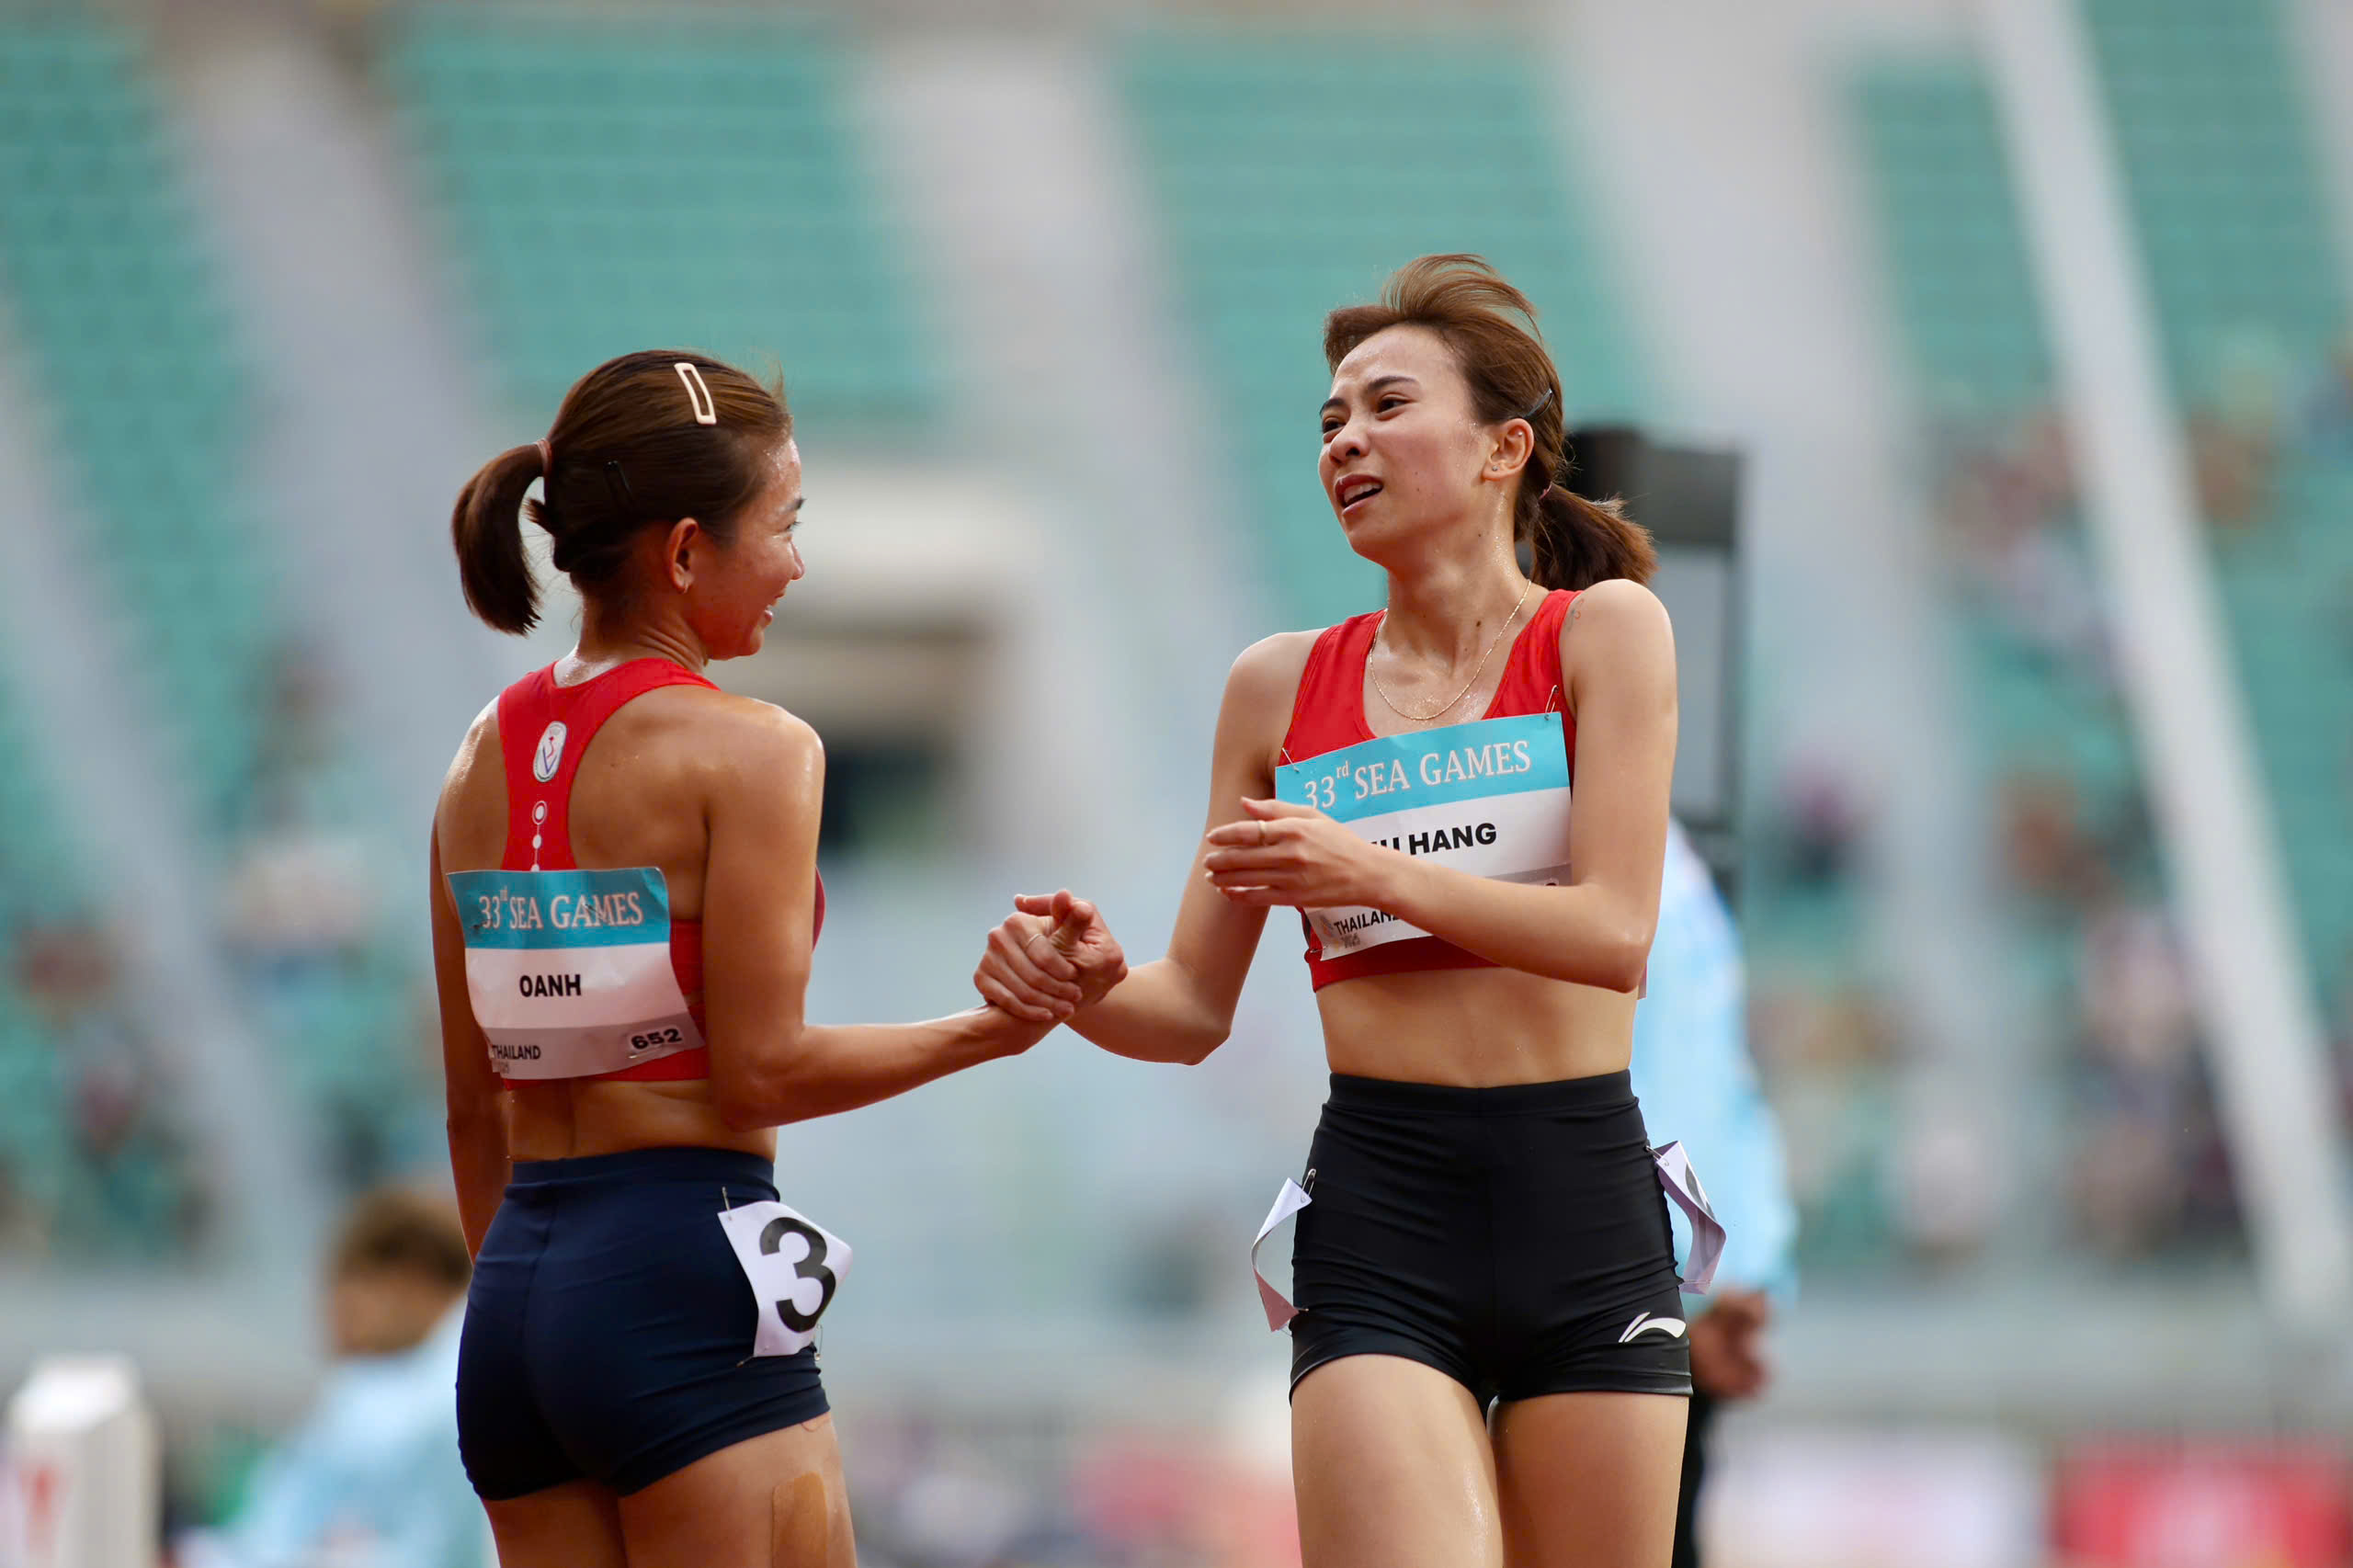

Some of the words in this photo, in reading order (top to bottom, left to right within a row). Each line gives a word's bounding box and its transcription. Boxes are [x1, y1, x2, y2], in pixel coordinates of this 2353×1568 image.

[1355, 759, 1410, 800] SEA
[1420, 741, 1531, 786] GAMES
[1408, 823, 1496, 856] HANG
[509, 896, 543, 929] SEA
[551, 892, 643, 928] GAMES
[1334, 911, 1399, 936] THAILAN
[519, 974, 581, 997] OANH
[631, 1028, 682, 1050] 652
[759, 1216, 836, 1334] 3
